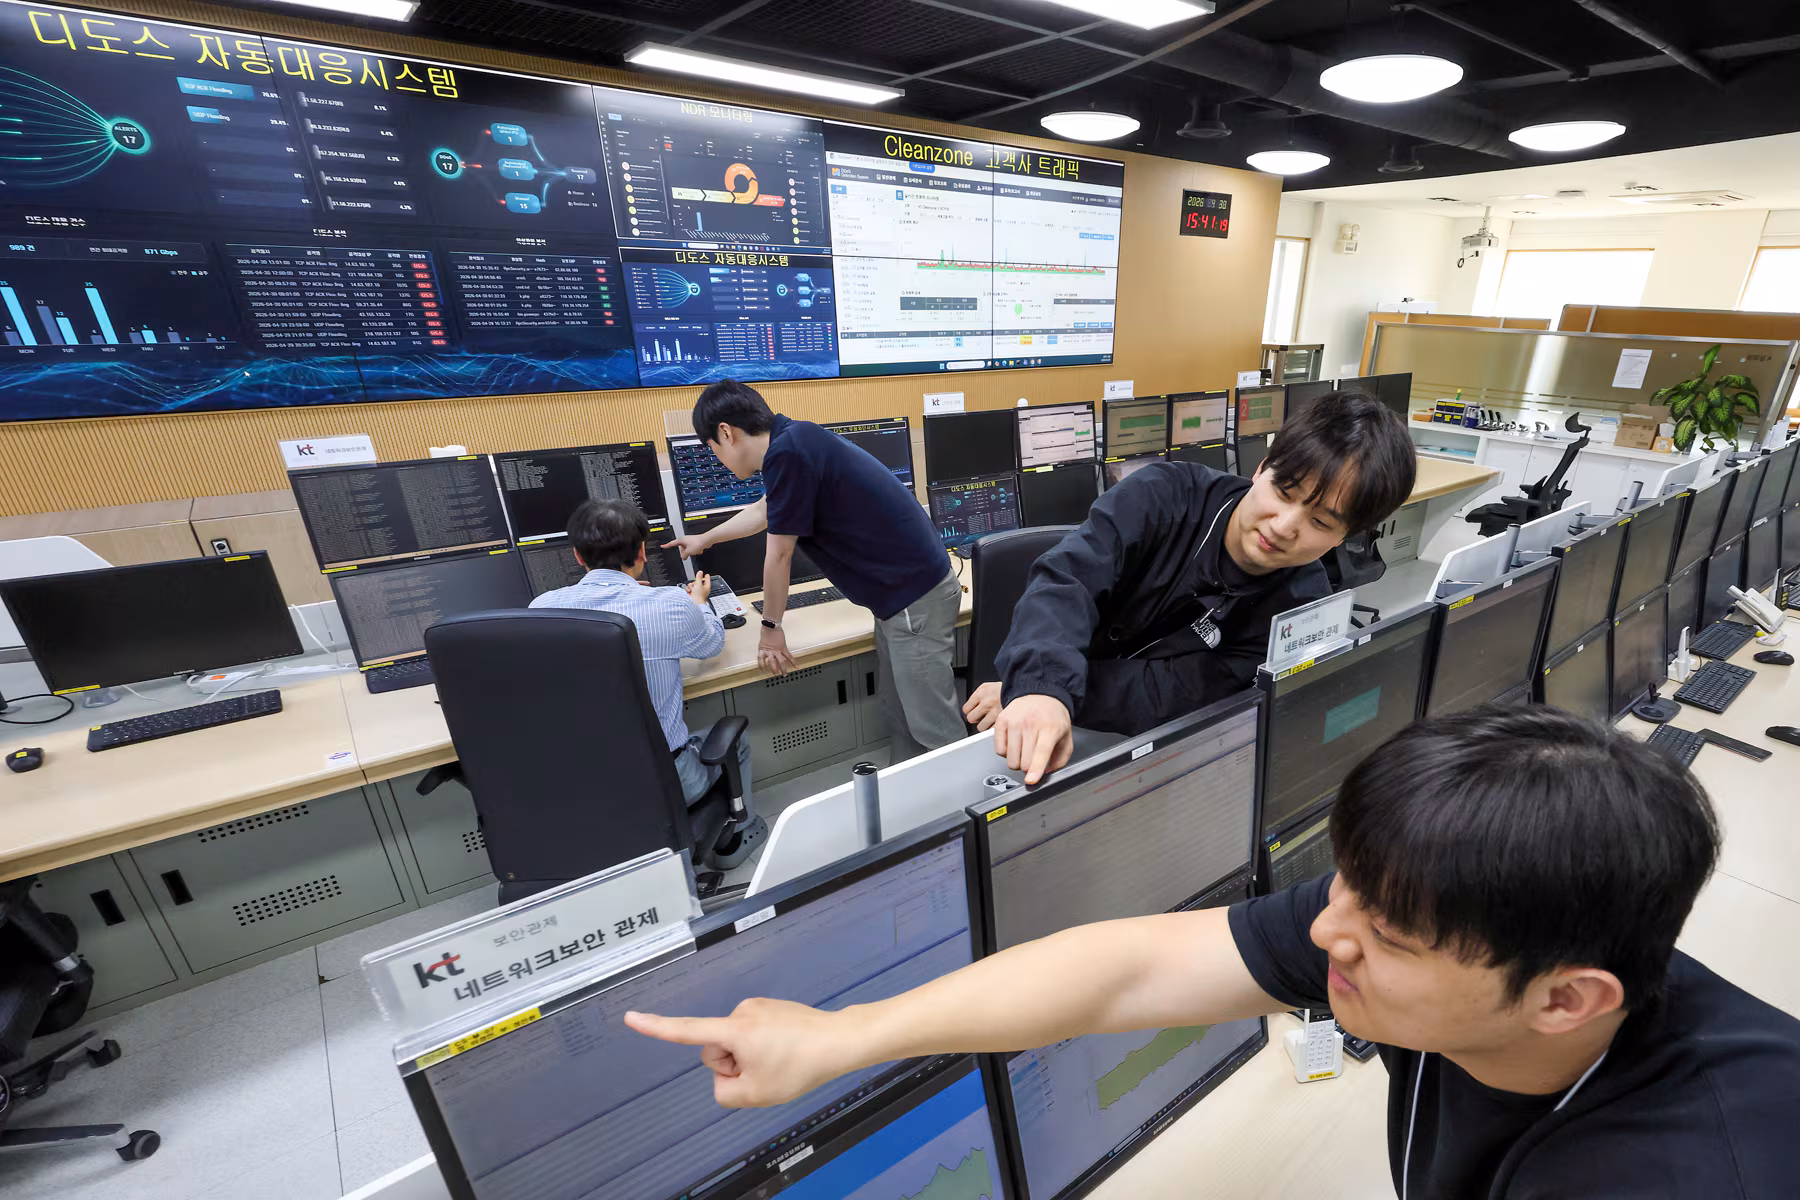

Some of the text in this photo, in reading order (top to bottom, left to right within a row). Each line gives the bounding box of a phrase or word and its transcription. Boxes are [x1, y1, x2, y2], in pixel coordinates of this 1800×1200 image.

[28, 11, 458, 98] 디도스 자동대응시스템
[681, 102, 753, 122] NDR 모니터링
[122, 135, 136, 144] 17
[442, 162, 453, 170] 17
[884, 135, 1080, 180] Cleanzone 고객사 트래픽
[675, 252, 789, 267] 디도스 자동대응시스템
[932, 398, 940, 406] kt
[296, 444, 315, 456] kt
[1280, 623, 1292, 641] kt
[1284, 624, 1339, 653] 네트워크보안 관제
[492, 914, 559, 948] 보안관제
[453, 906, 661, 1001] 네트워크보안 관제
[413, 951, 465, 990] kt
[766, 1142, 806, 1169] SAMSUNG
